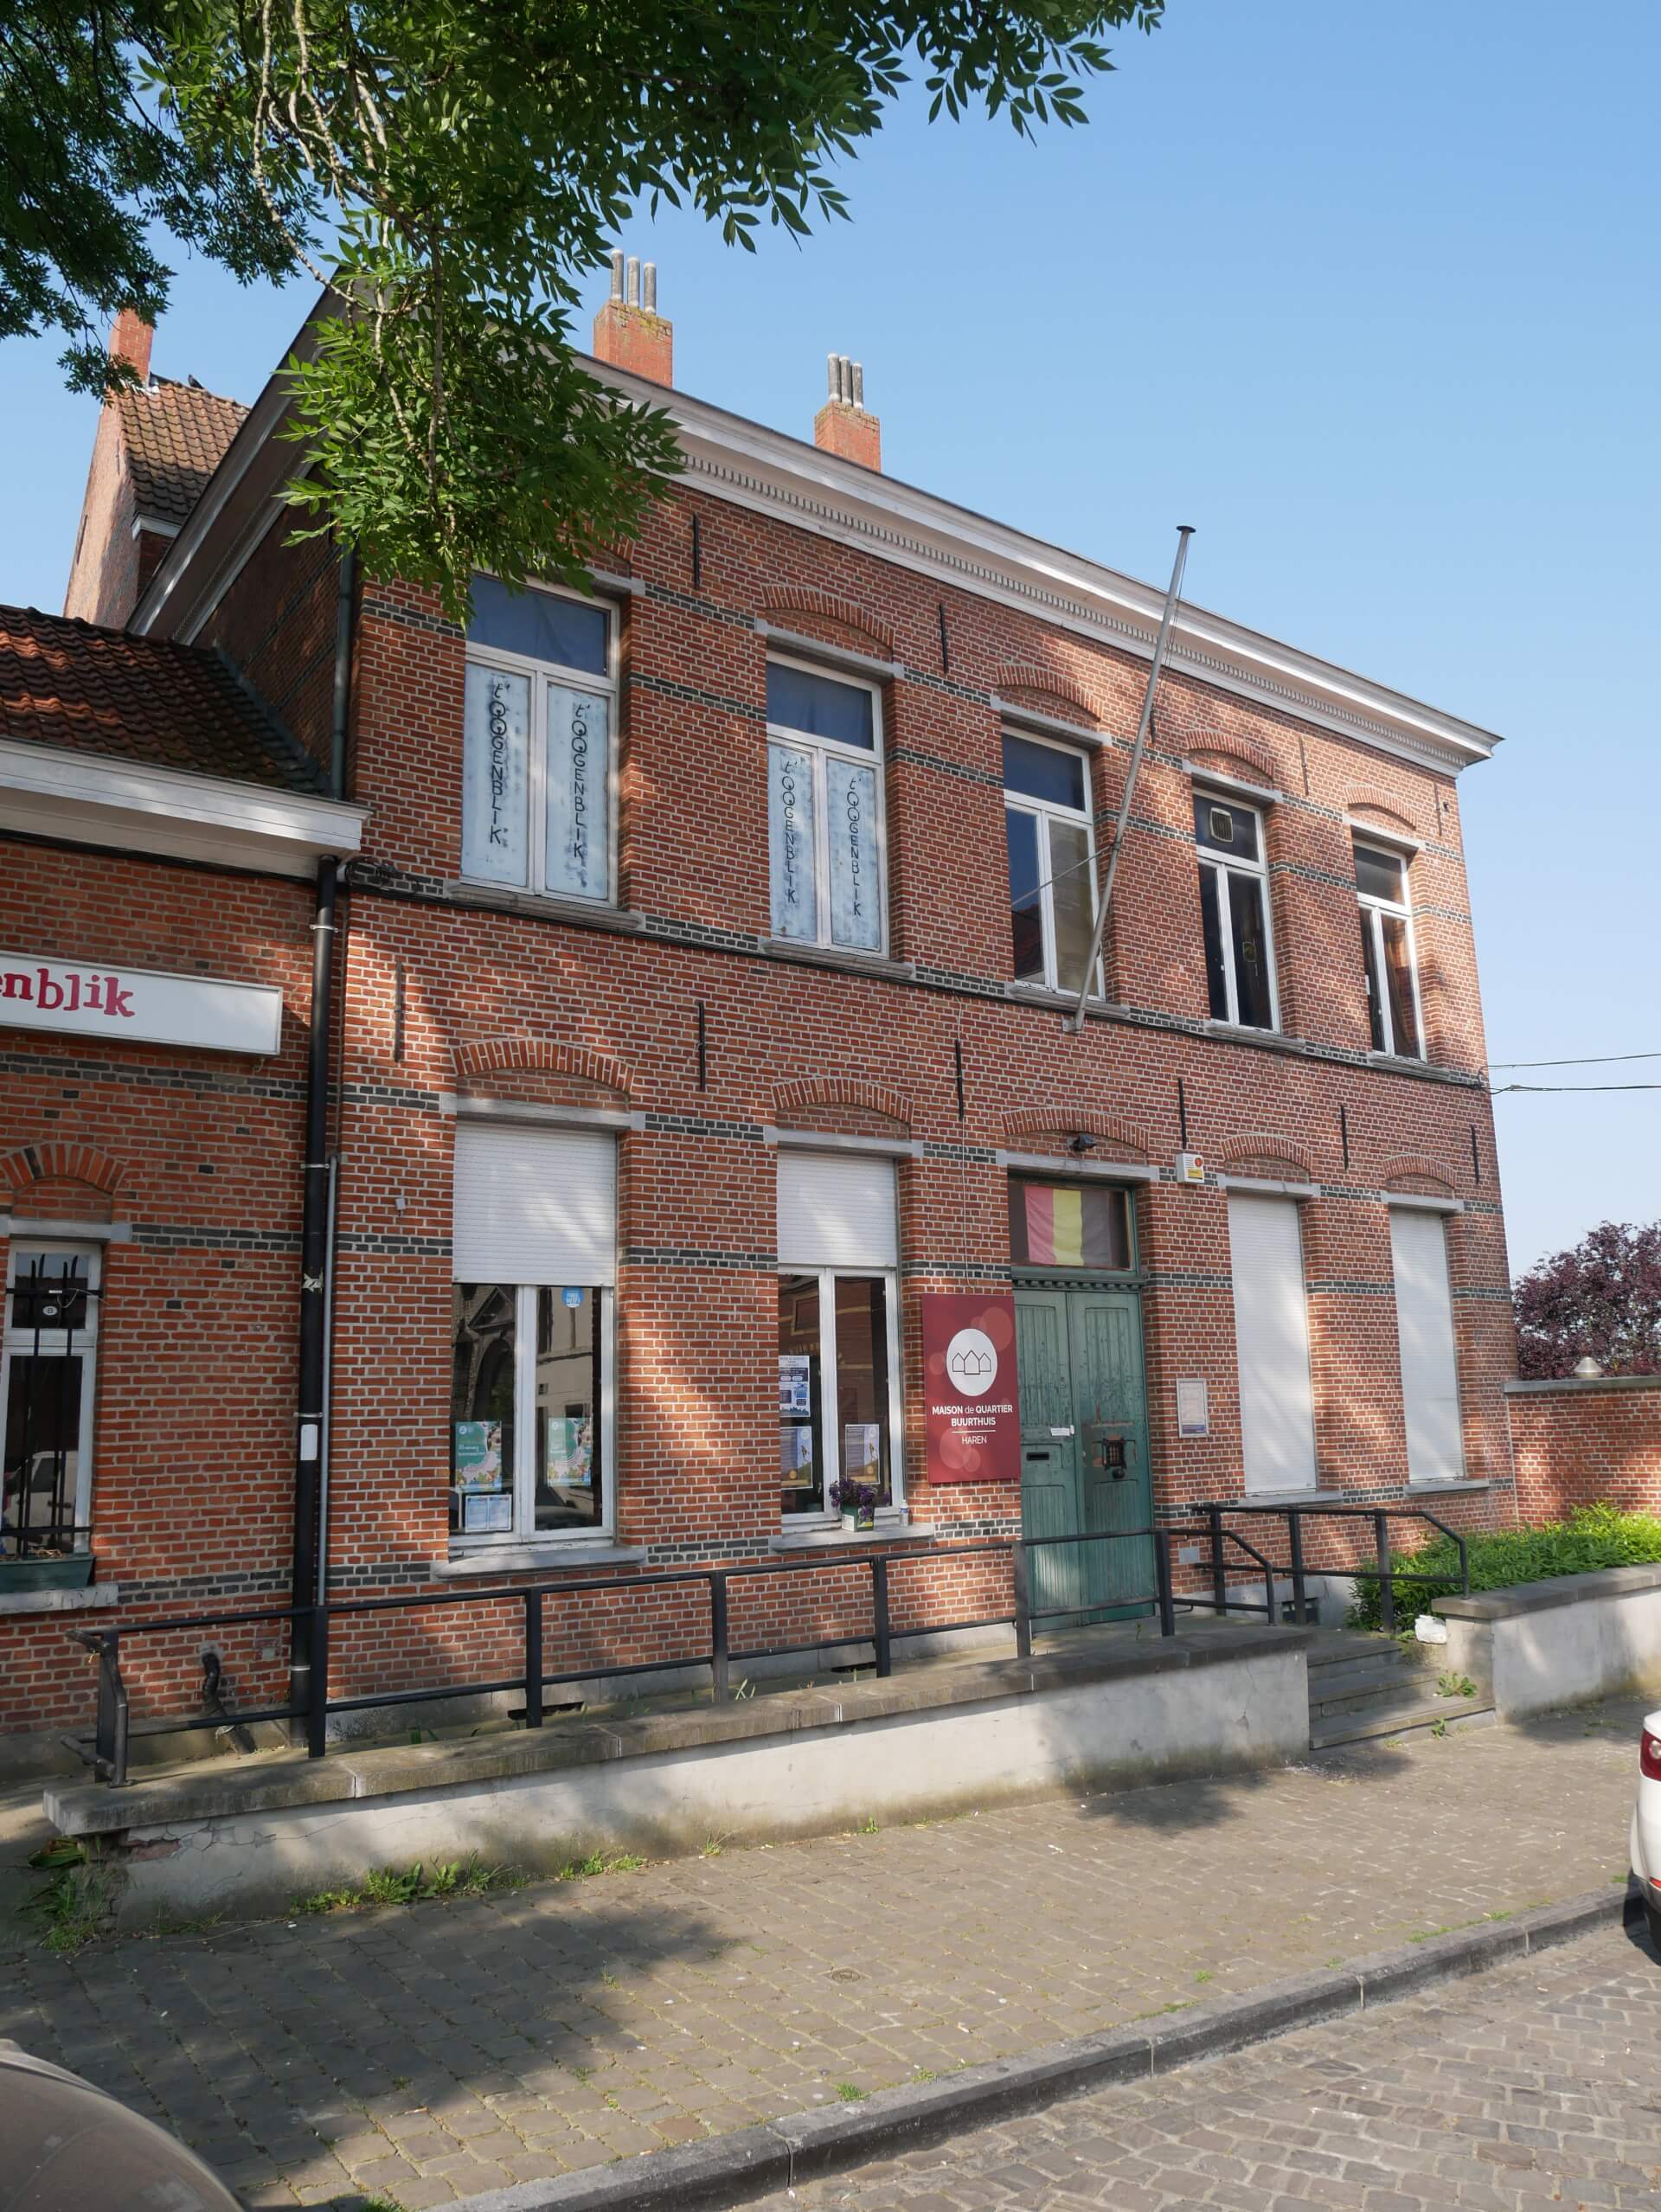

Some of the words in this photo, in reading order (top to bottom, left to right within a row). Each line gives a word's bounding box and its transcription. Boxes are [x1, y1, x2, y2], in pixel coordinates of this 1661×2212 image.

[0, 967, 136, 1017] nblik
[932, 1406, 963, 1415] MAISON
[965, 1406, 974, 1414] de
[975, 1404, 1013, 1414] QUARTIER
[951, 1417, 997, 1427] BUURTHUIS
[961, 1436, 987, 1445] HAREN
